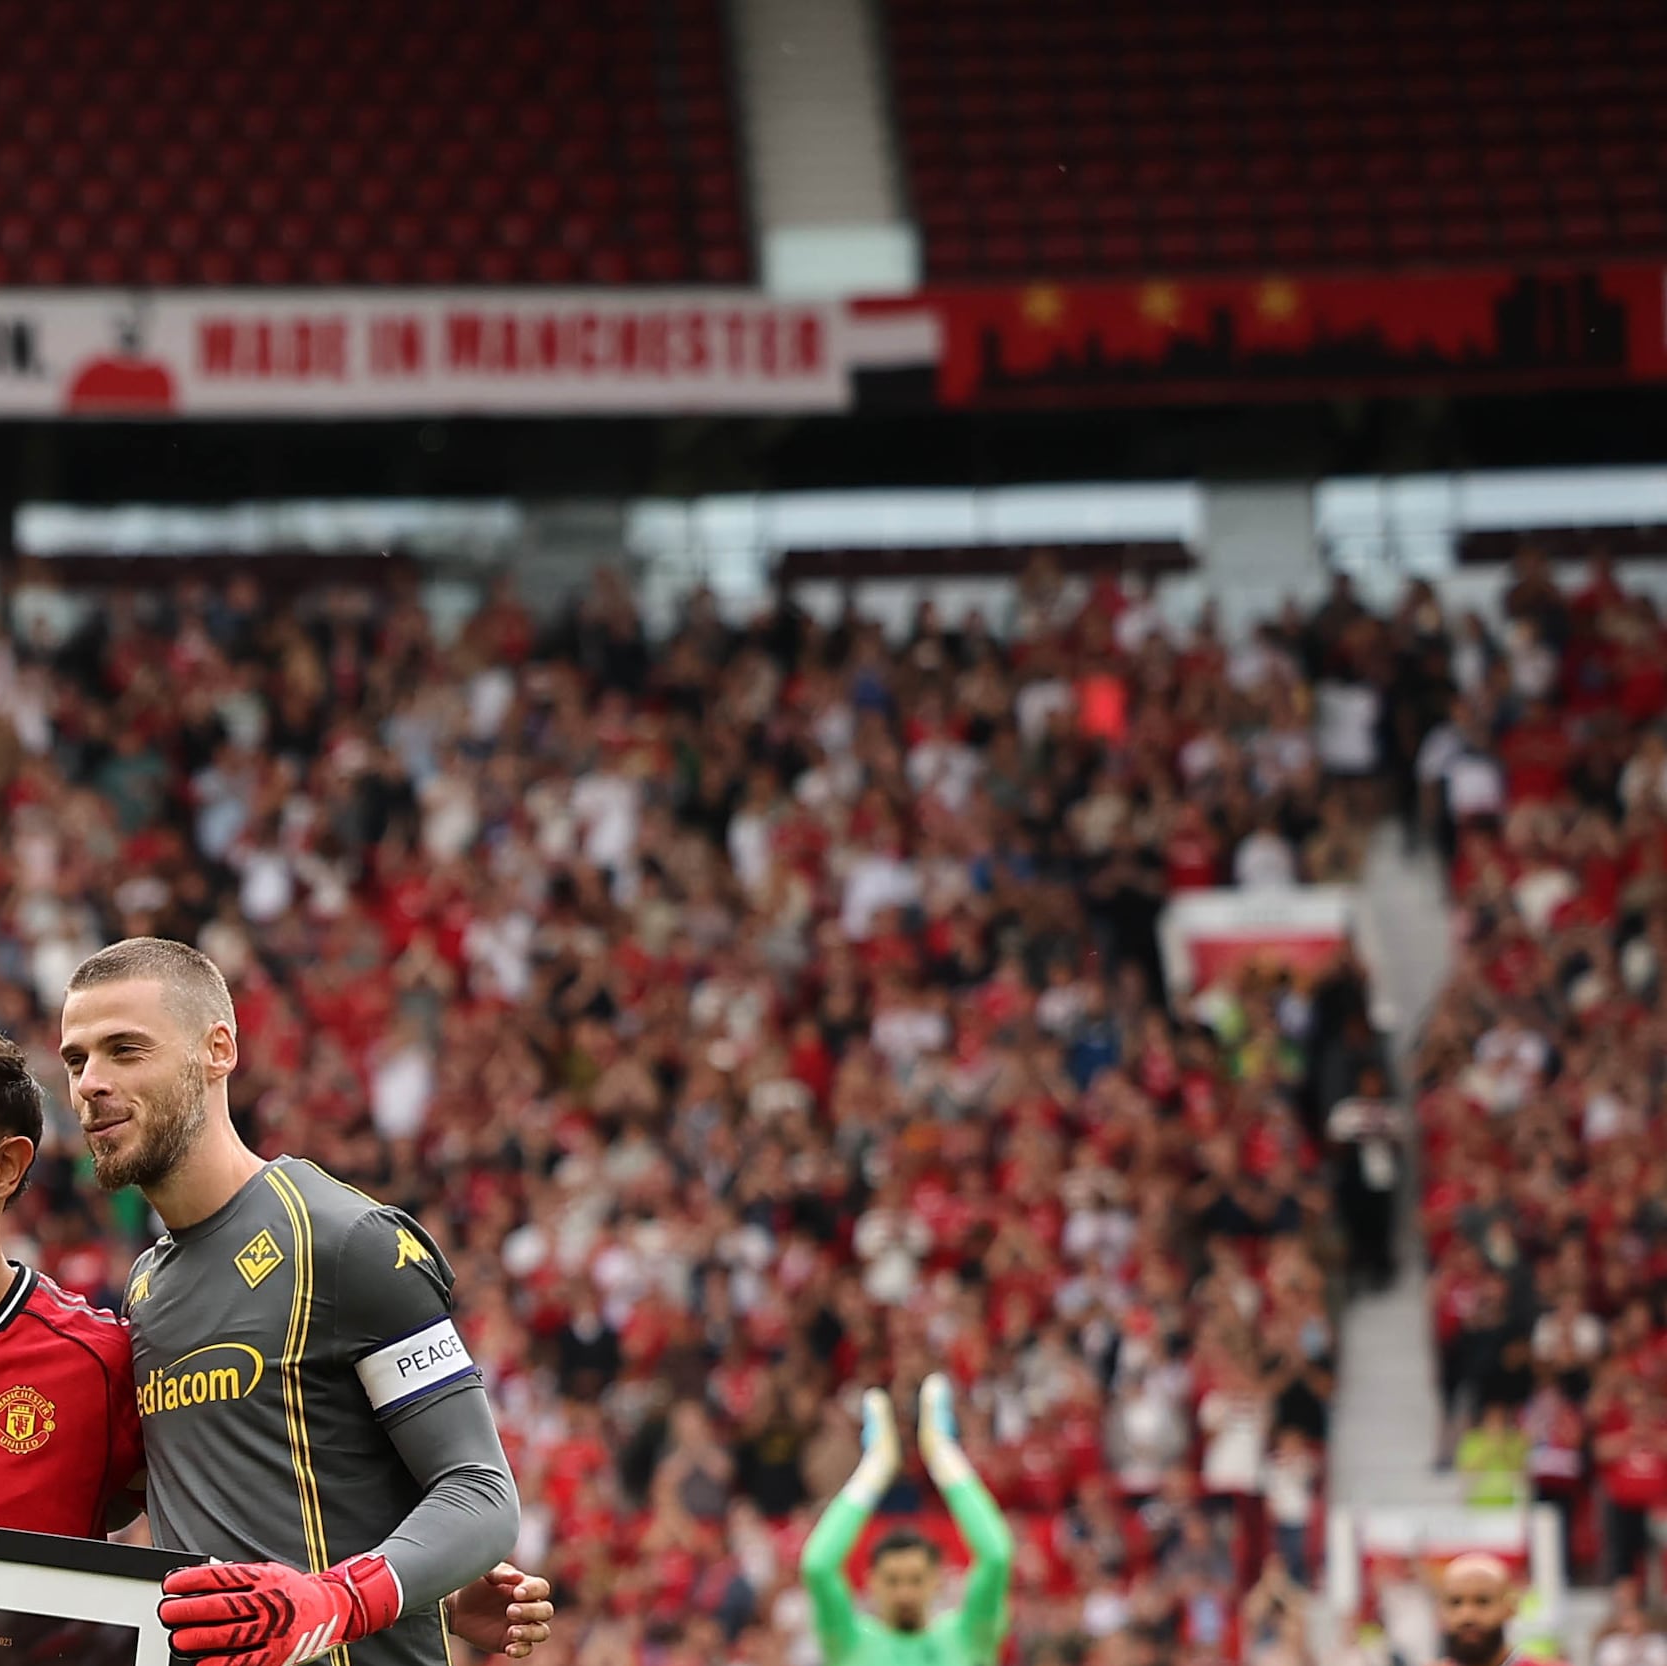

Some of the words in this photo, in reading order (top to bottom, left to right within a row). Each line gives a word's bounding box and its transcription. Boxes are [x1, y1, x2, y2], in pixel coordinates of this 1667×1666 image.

[195, 313, 349, 378] MADE
[443, 311, 823, 380] MANCHESTER
[396, 1335, 462, 1378] PEACE
[136, 1367, 240, 1418] ediacom
[0, 1435, 39, 1450] UNITED
